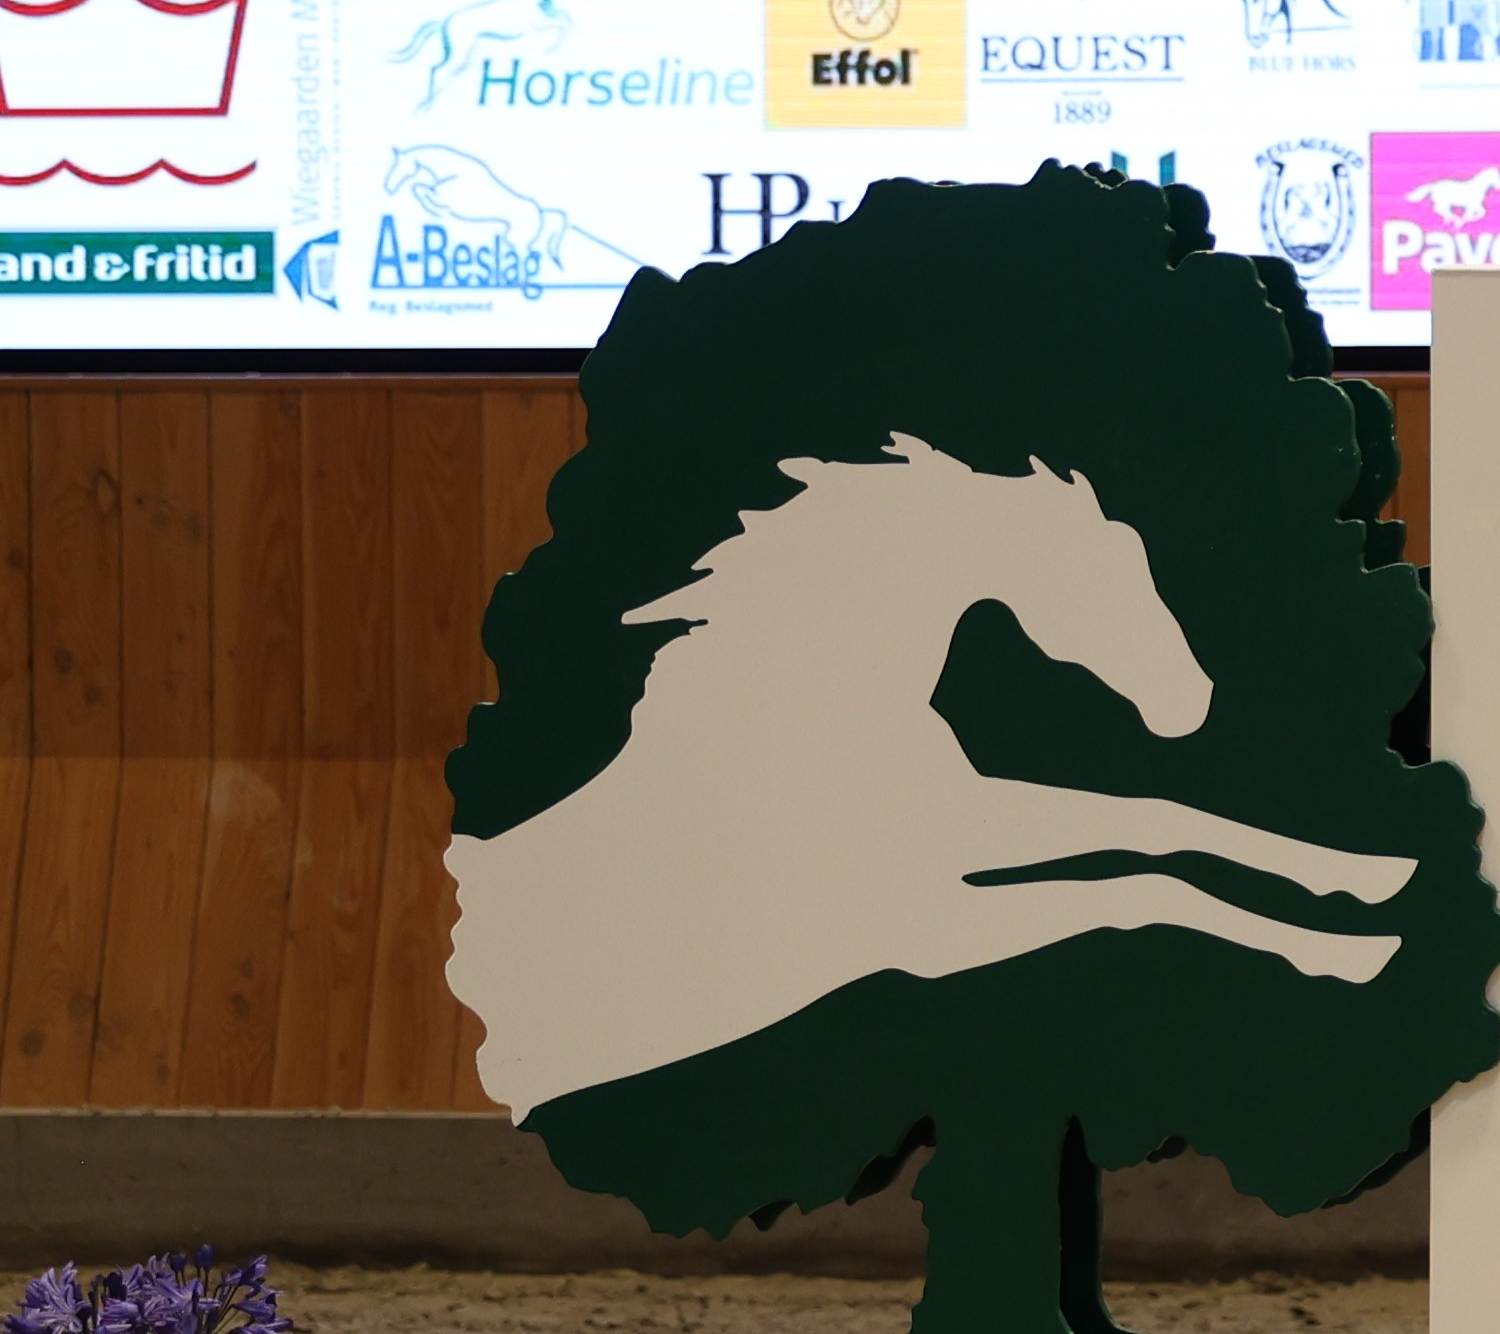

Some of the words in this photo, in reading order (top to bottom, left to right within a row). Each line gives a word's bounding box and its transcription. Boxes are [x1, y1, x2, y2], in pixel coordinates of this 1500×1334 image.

[811, 48, 911, 87] Effol
[981, 34, 1185, 73] EQUEST
[477, 58, 754, 107] Horseline
[1053, 101, 1112, 124] 1889
[370, 215, 542, 300] A-Beslag
